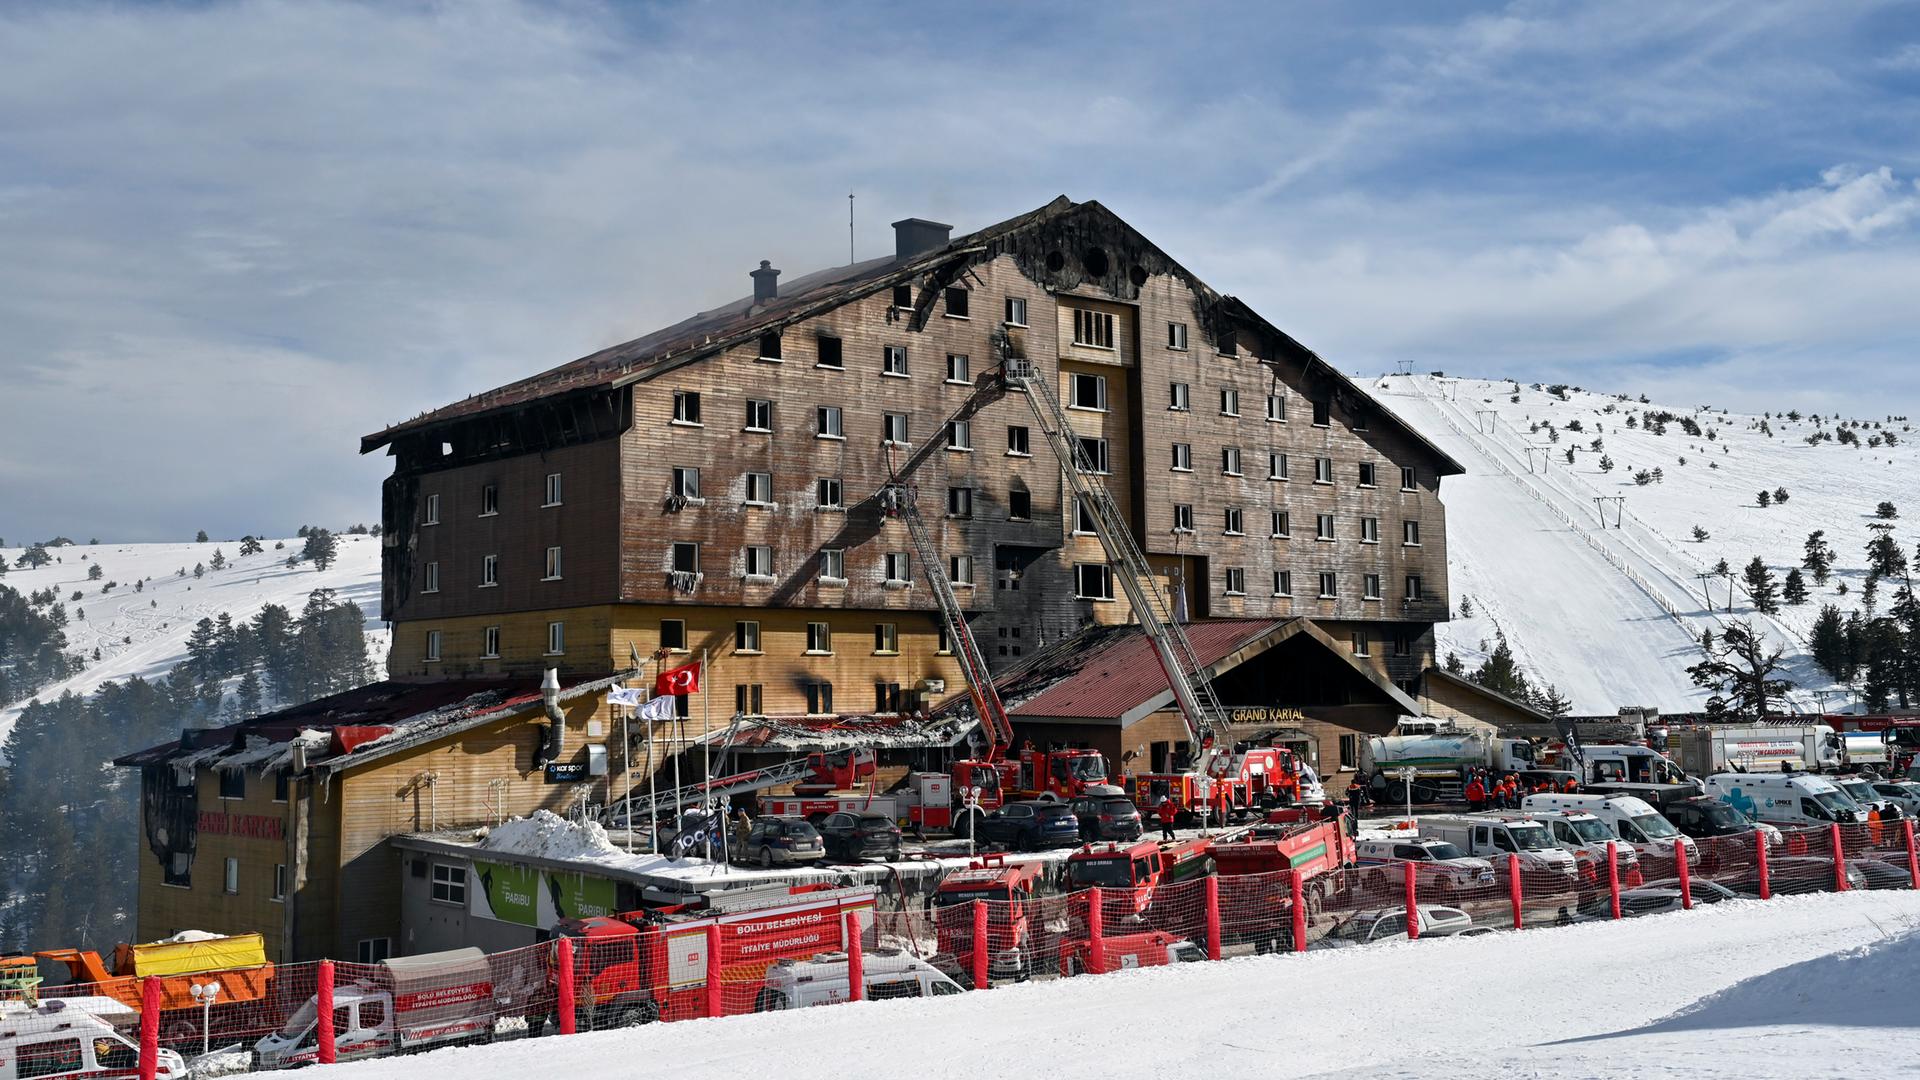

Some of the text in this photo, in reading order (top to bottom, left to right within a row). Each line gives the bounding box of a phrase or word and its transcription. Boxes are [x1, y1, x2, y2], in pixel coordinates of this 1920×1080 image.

[1233, 708, 1305, 721] GRAND KARTAL
[736, 912, 822, 935] BOLU BELEDİYESİ
[741, 934, 820, 954] İTFAİYE MÜDÜRLÜĞÜ
[417, 993, 435, 1001] BOLU
[829, 990, 840, 998] T.C.
